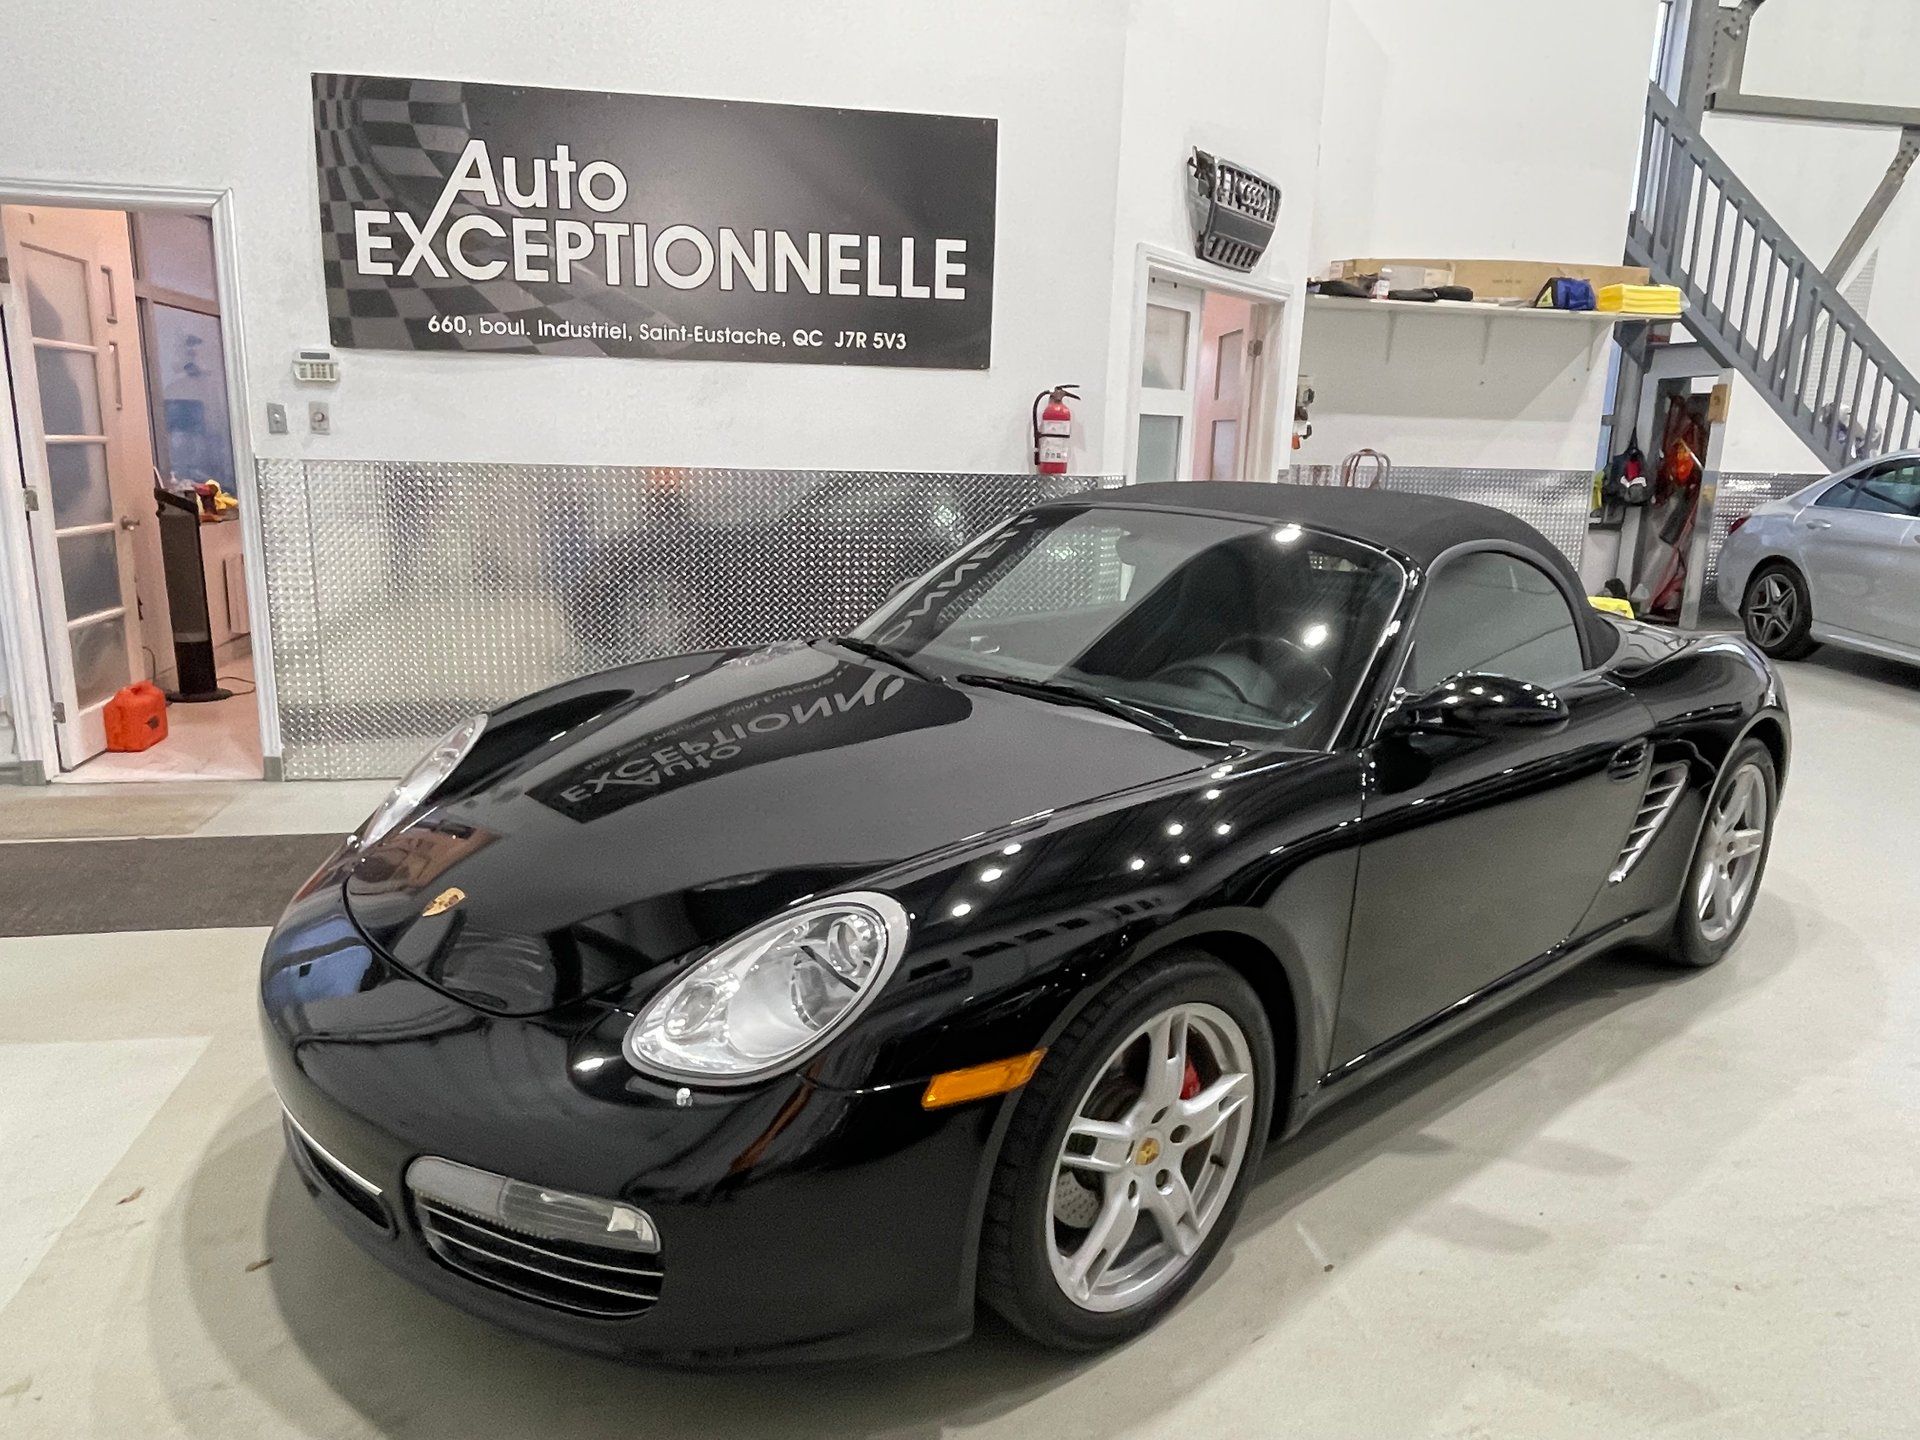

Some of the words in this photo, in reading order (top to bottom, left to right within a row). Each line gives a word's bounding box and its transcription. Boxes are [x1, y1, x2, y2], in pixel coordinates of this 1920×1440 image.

[440, 138, 627, 213] Auto
[354, 206, 967, 300] EXCEPTIONNELLE
[427, 314, 476, 337] 660,
[479, 317, 531, 337] boul.
[537, 319, 634, 342] Industriel,
[639, 323, 786, 348] Saint-Eustache,
[792, 329, 823, 347] QC
[834, 330, 867, 349] J7R
[872, 332, 907, 350] 5V3
